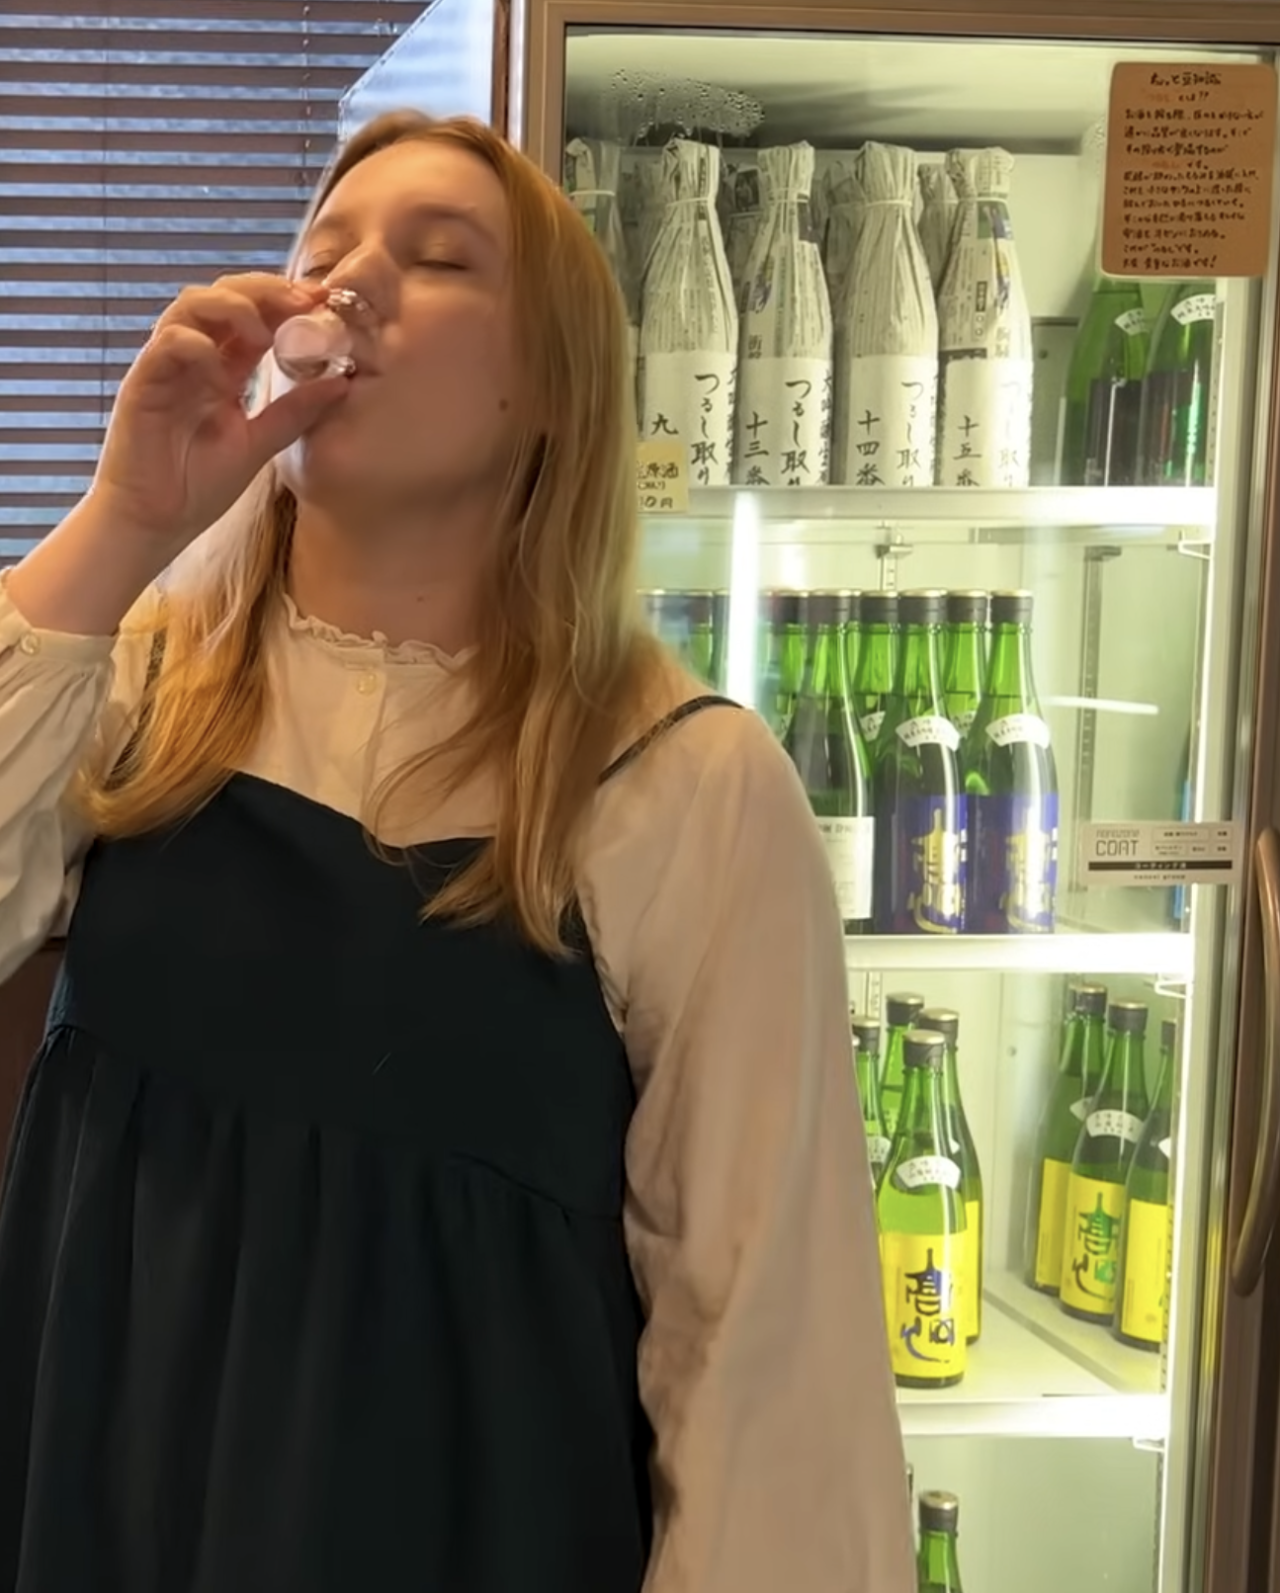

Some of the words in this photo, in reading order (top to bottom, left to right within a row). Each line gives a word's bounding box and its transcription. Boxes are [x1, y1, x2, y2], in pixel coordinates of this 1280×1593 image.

[690, 373, 720, 486] つるし取り
[896, 381, 925, 487] つるし取り
[1096, 839, 1139, 857] COAT
